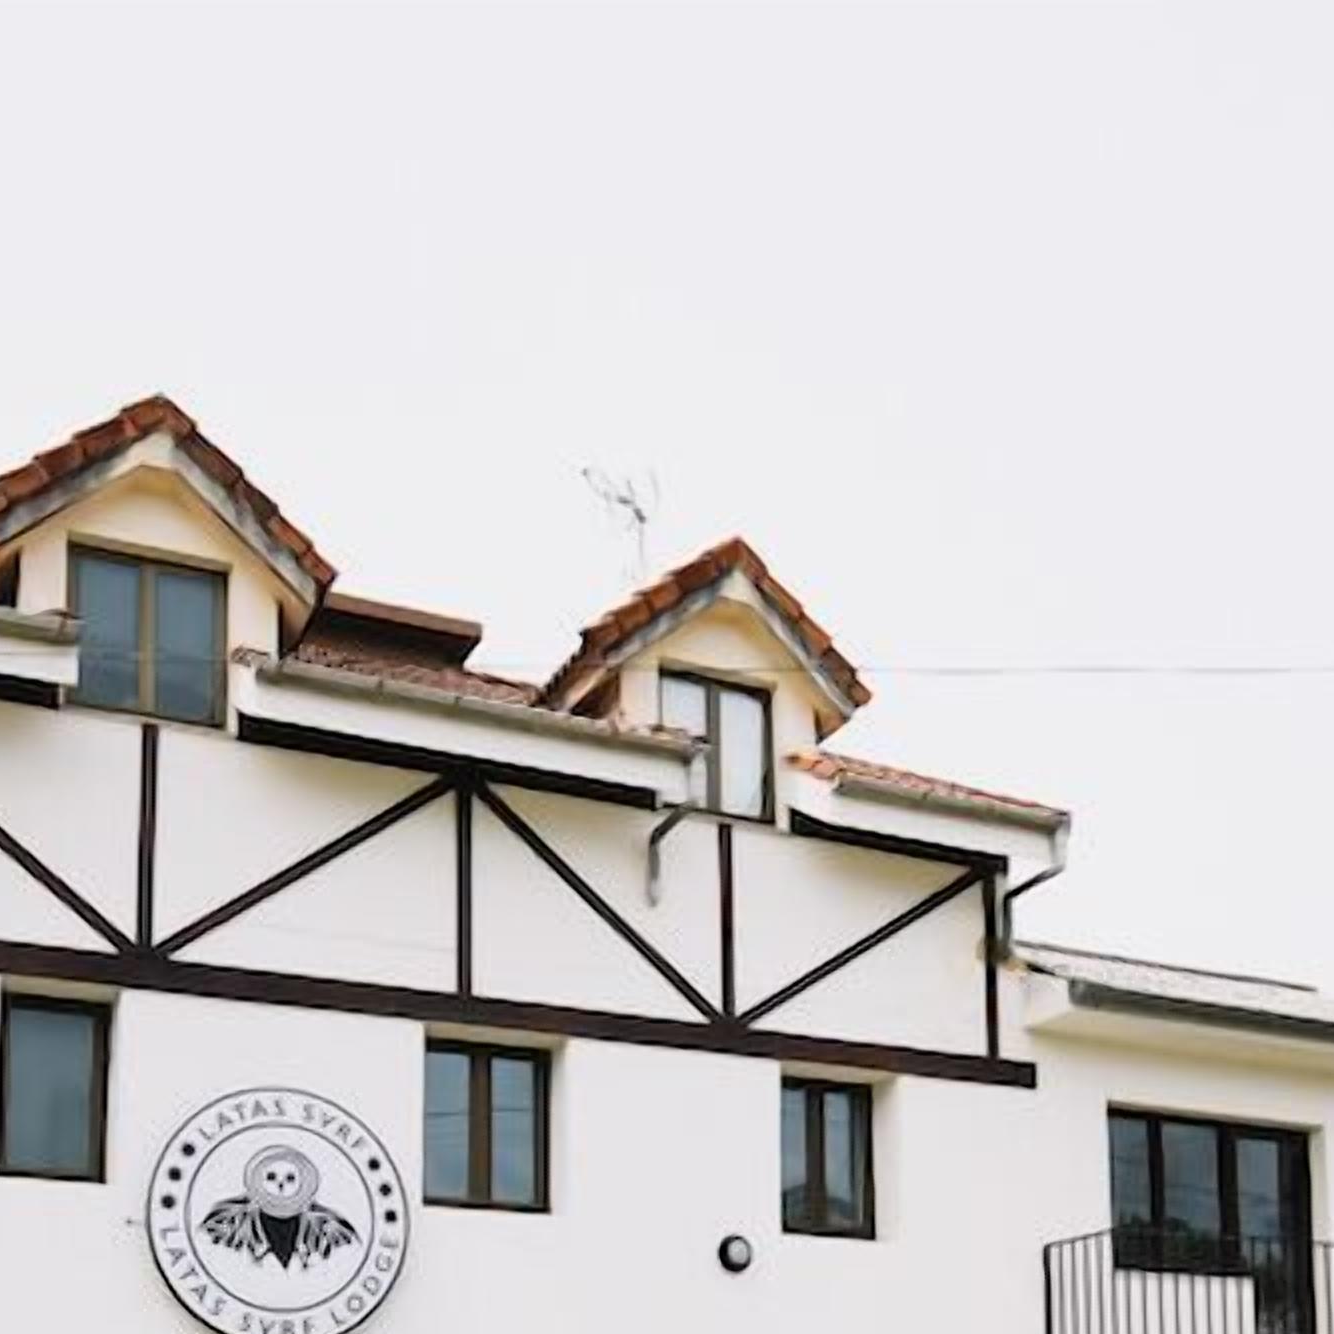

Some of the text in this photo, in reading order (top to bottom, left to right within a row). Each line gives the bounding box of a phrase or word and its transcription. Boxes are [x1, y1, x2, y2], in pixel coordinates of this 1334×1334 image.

[199, 1099, 287, 1141] LATAS
[160, 1226, 228, 1317] LATAS
[331, 1238, 399, 1325] LODGE
